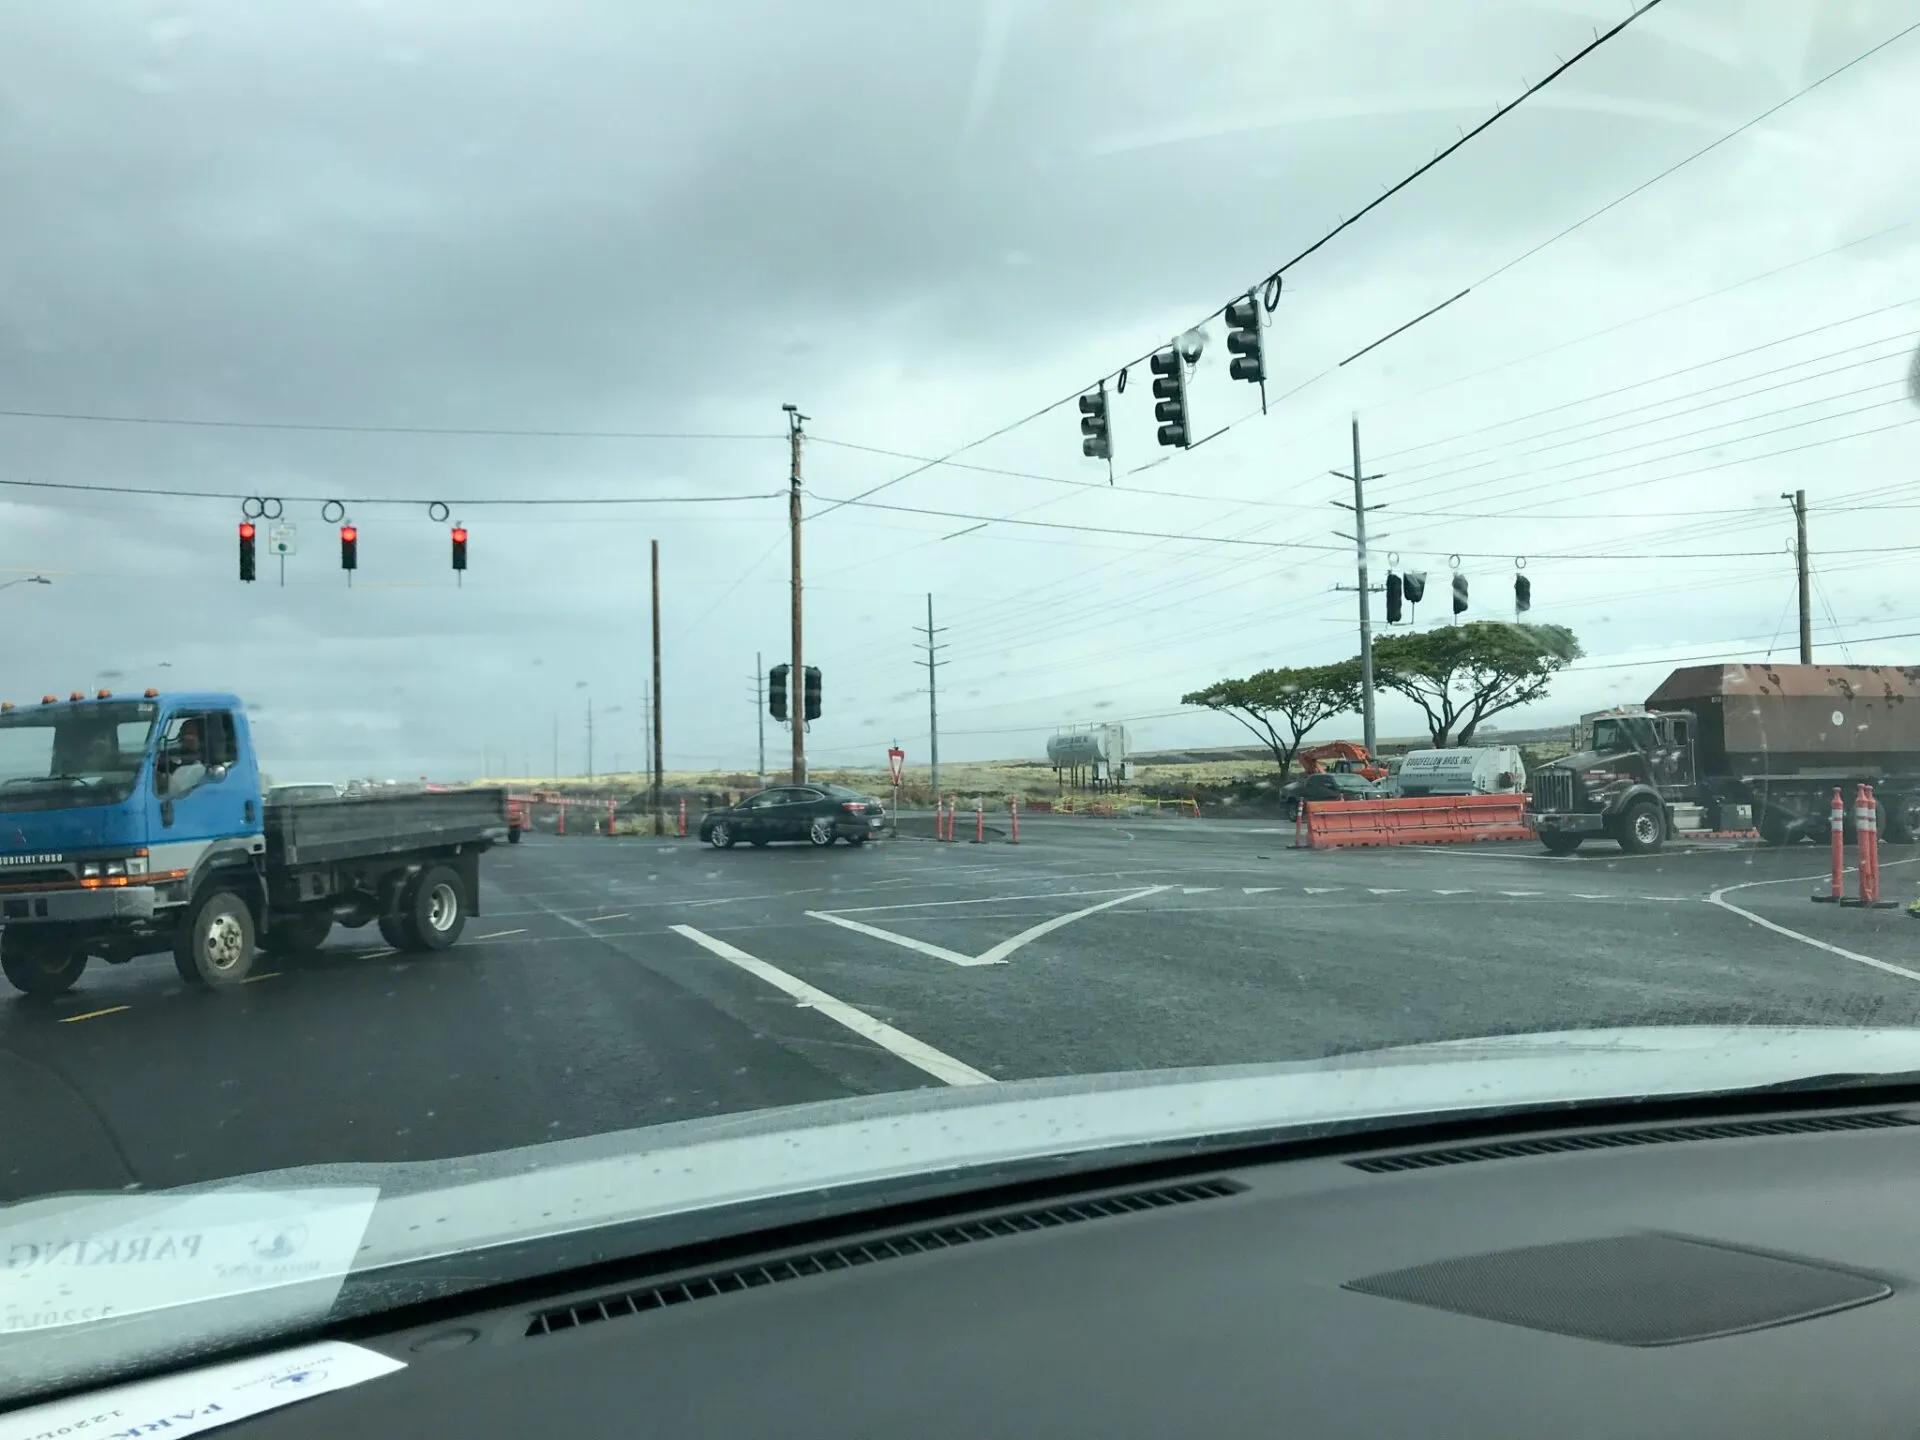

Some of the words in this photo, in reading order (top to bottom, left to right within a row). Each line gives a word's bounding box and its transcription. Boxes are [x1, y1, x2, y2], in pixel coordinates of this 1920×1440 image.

[1406, 757, 1442, 767] GOODFELLOW
[39, 853, 63, 863] FUSO
[98, 1403, 223, 1440] PARK
